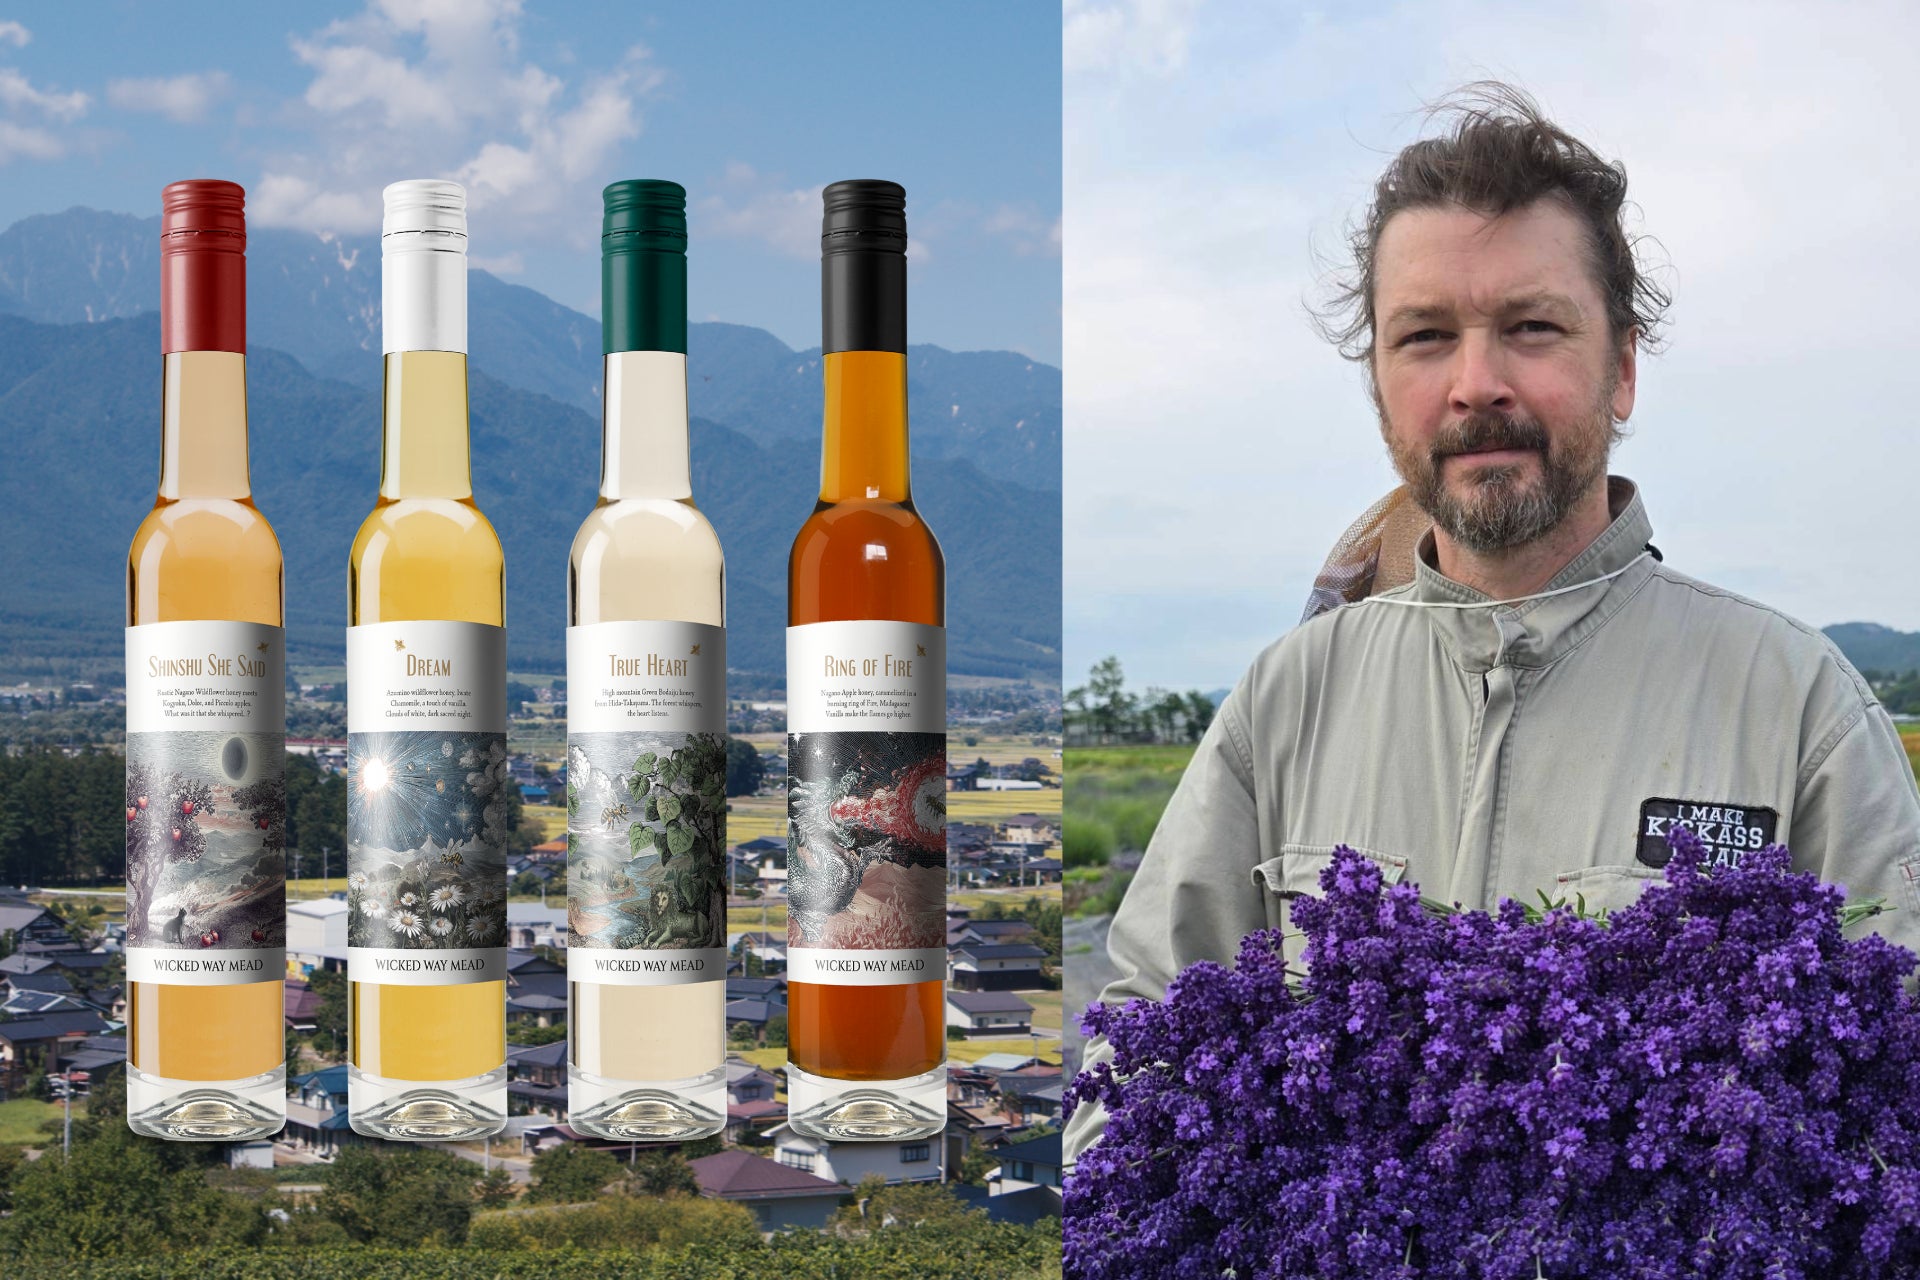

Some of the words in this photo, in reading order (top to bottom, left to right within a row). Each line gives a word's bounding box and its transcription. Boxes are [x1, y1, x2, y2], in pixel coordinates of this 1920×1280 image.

[175, 689, 194, 697] Nagano
[226, 689, 241, 697] honey
[602, 689, 615, 697] High
[659, 688, 678, 697] Bodaiju
[680, 689, 695, 697] honey
[821, 690, 840, 698] Nagano
[842, 689, 856, 698] Apple
[827, 700, 847, 708] burning
[849, 700, 859, 708] ring
[880, 700, 910, 708] Madagascar
[1677, 805, 1684, 818] I
[1690, 806, 1744, 825] MAKE
[154, 959, 199, 971] WICKED
[202, 960, 225, 972] WAY
[229, 959, 263, 971] MEAD
[375, 959, 420, 971] WICKED
[423, 960, 447, 971] WAY
[451, 959, 484, 971] MEAD
[595, 959, 640, 971] WICKED
[643, 960, 667, 972] WAY
[670, 959, 704, 971] MEAD
[815, 959, 860, 971] WICKED
[863, 960, 887, 972] WAY
[890, 959, 924, 971] MEAD
